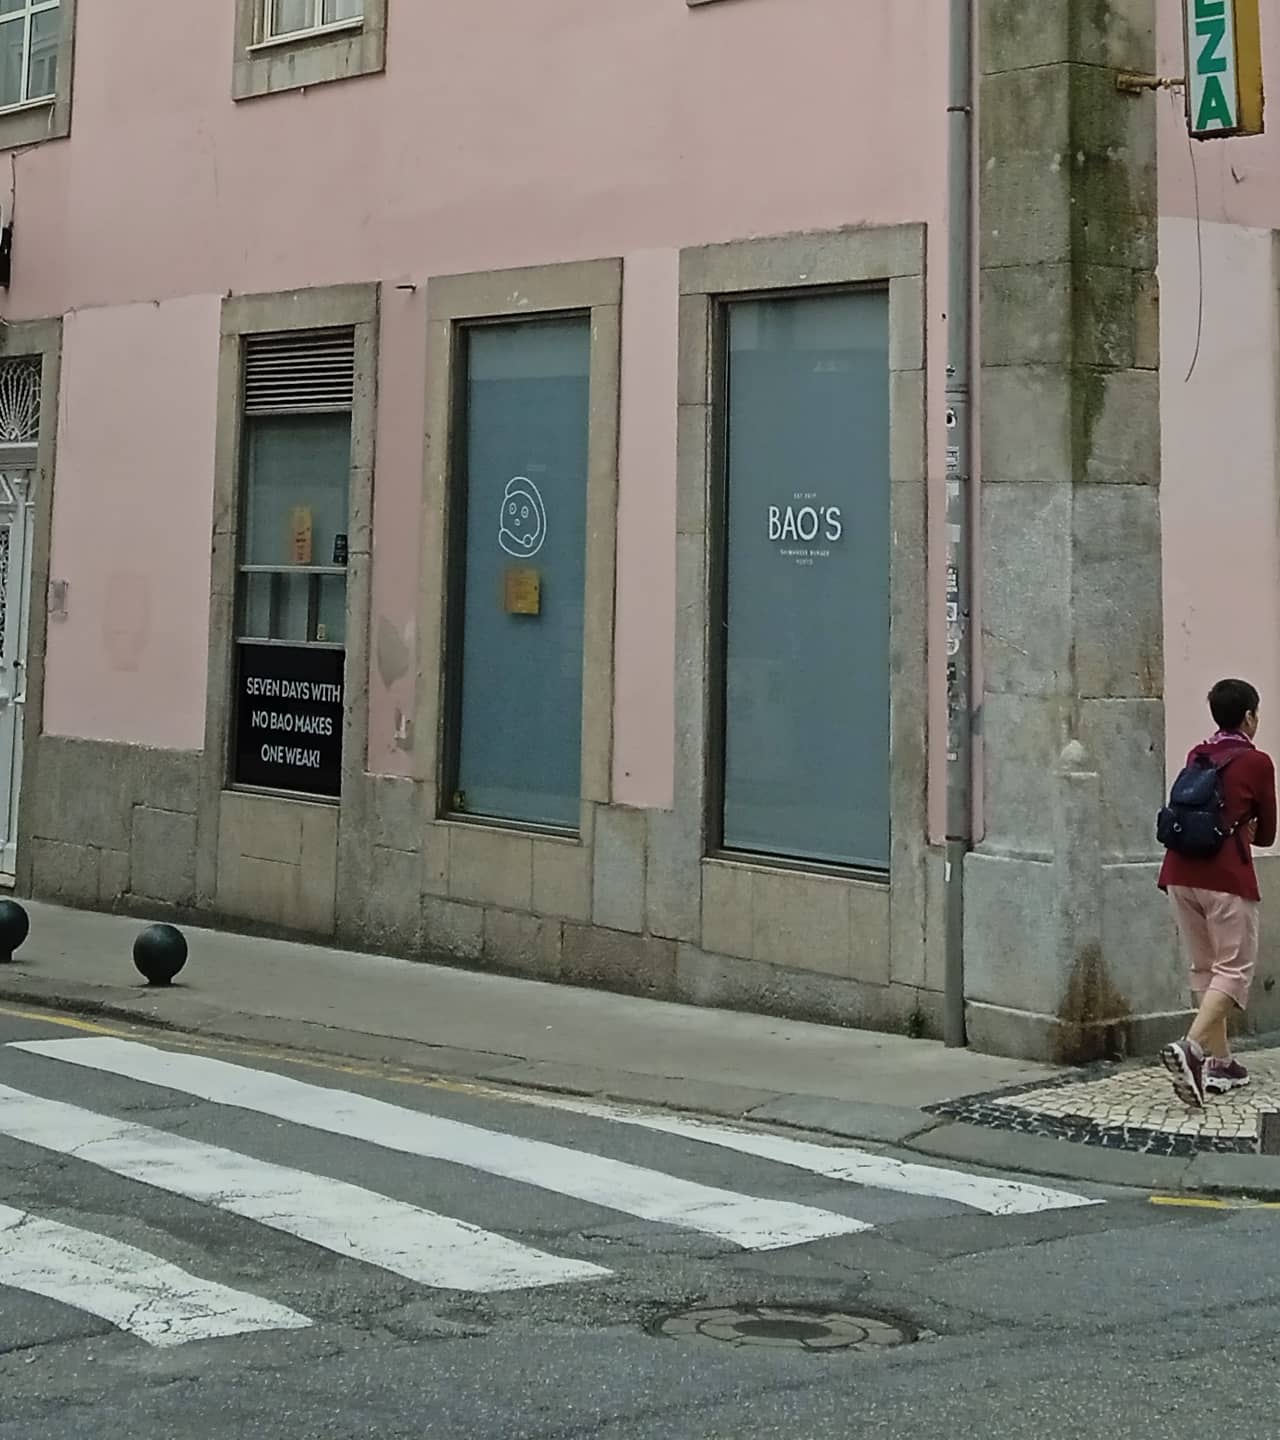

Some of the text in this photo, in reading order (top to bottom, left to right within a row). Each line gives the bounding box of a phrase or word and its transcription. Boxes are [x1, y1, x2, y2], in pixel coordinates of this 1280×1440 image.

[768, 505, 842, 541] BAO'S
[246, 676, 341, 703] SEVEN DAYS WITH
[251, 710, 333, 736] NO BAO MAKES
[260, 743, 321, 768] ONE WEAK!
